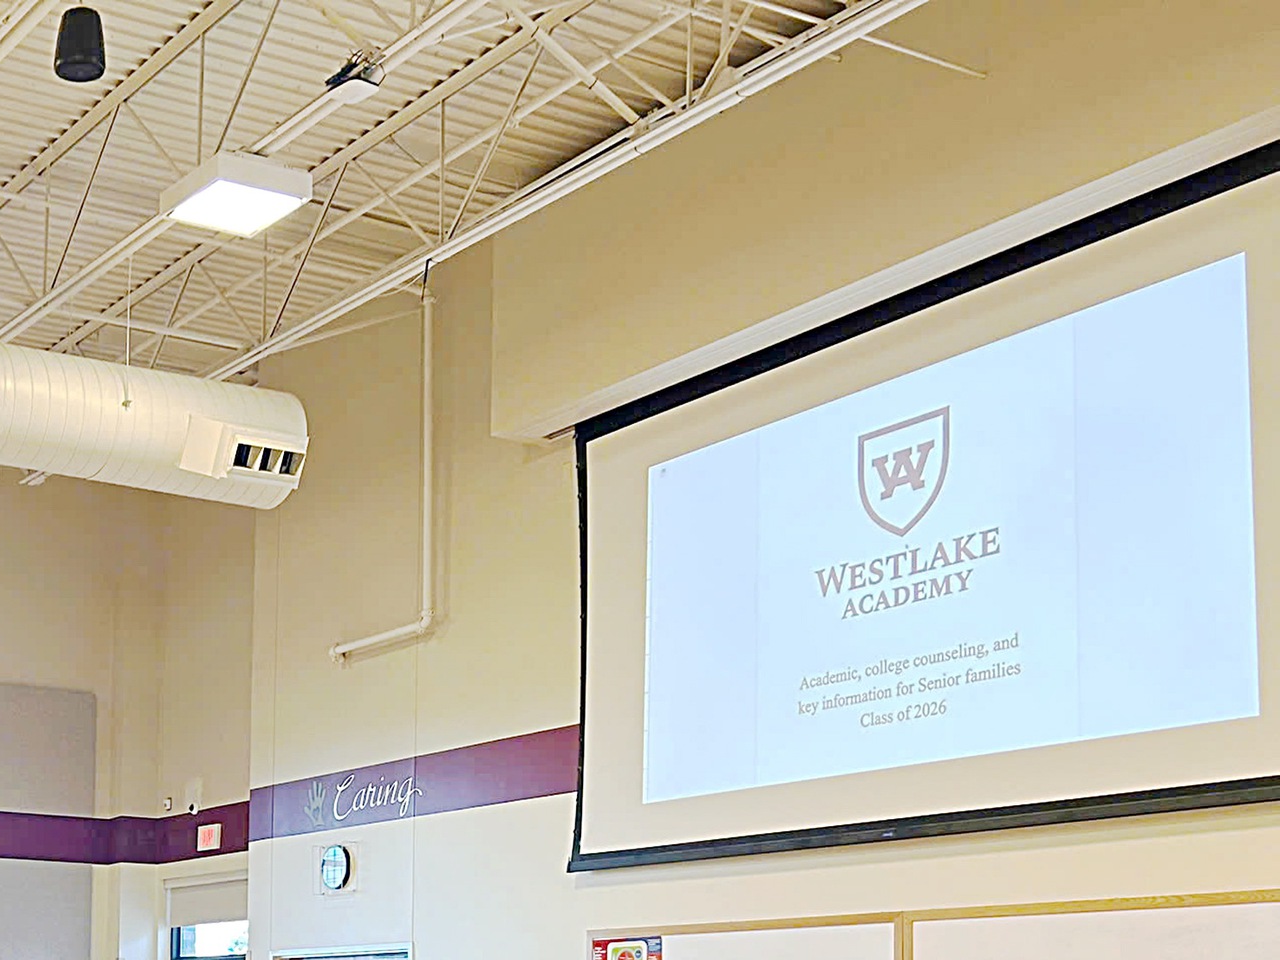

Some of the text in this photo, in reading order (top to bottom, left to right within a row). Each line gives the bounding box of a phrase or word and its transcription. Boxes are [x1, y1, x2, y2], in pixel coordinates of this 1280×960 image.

[815, 527, 1000, 598] WESTLAKE
[841, 569, 974, 620] ACADEMY
[799, 632, 1019, 691] Academic, college counseling, and
[798, 661, 1022, 716] key information for Senior families
[860, 699, 948, 728] Class of 2026
[332, 774, 423, 821] Caring
